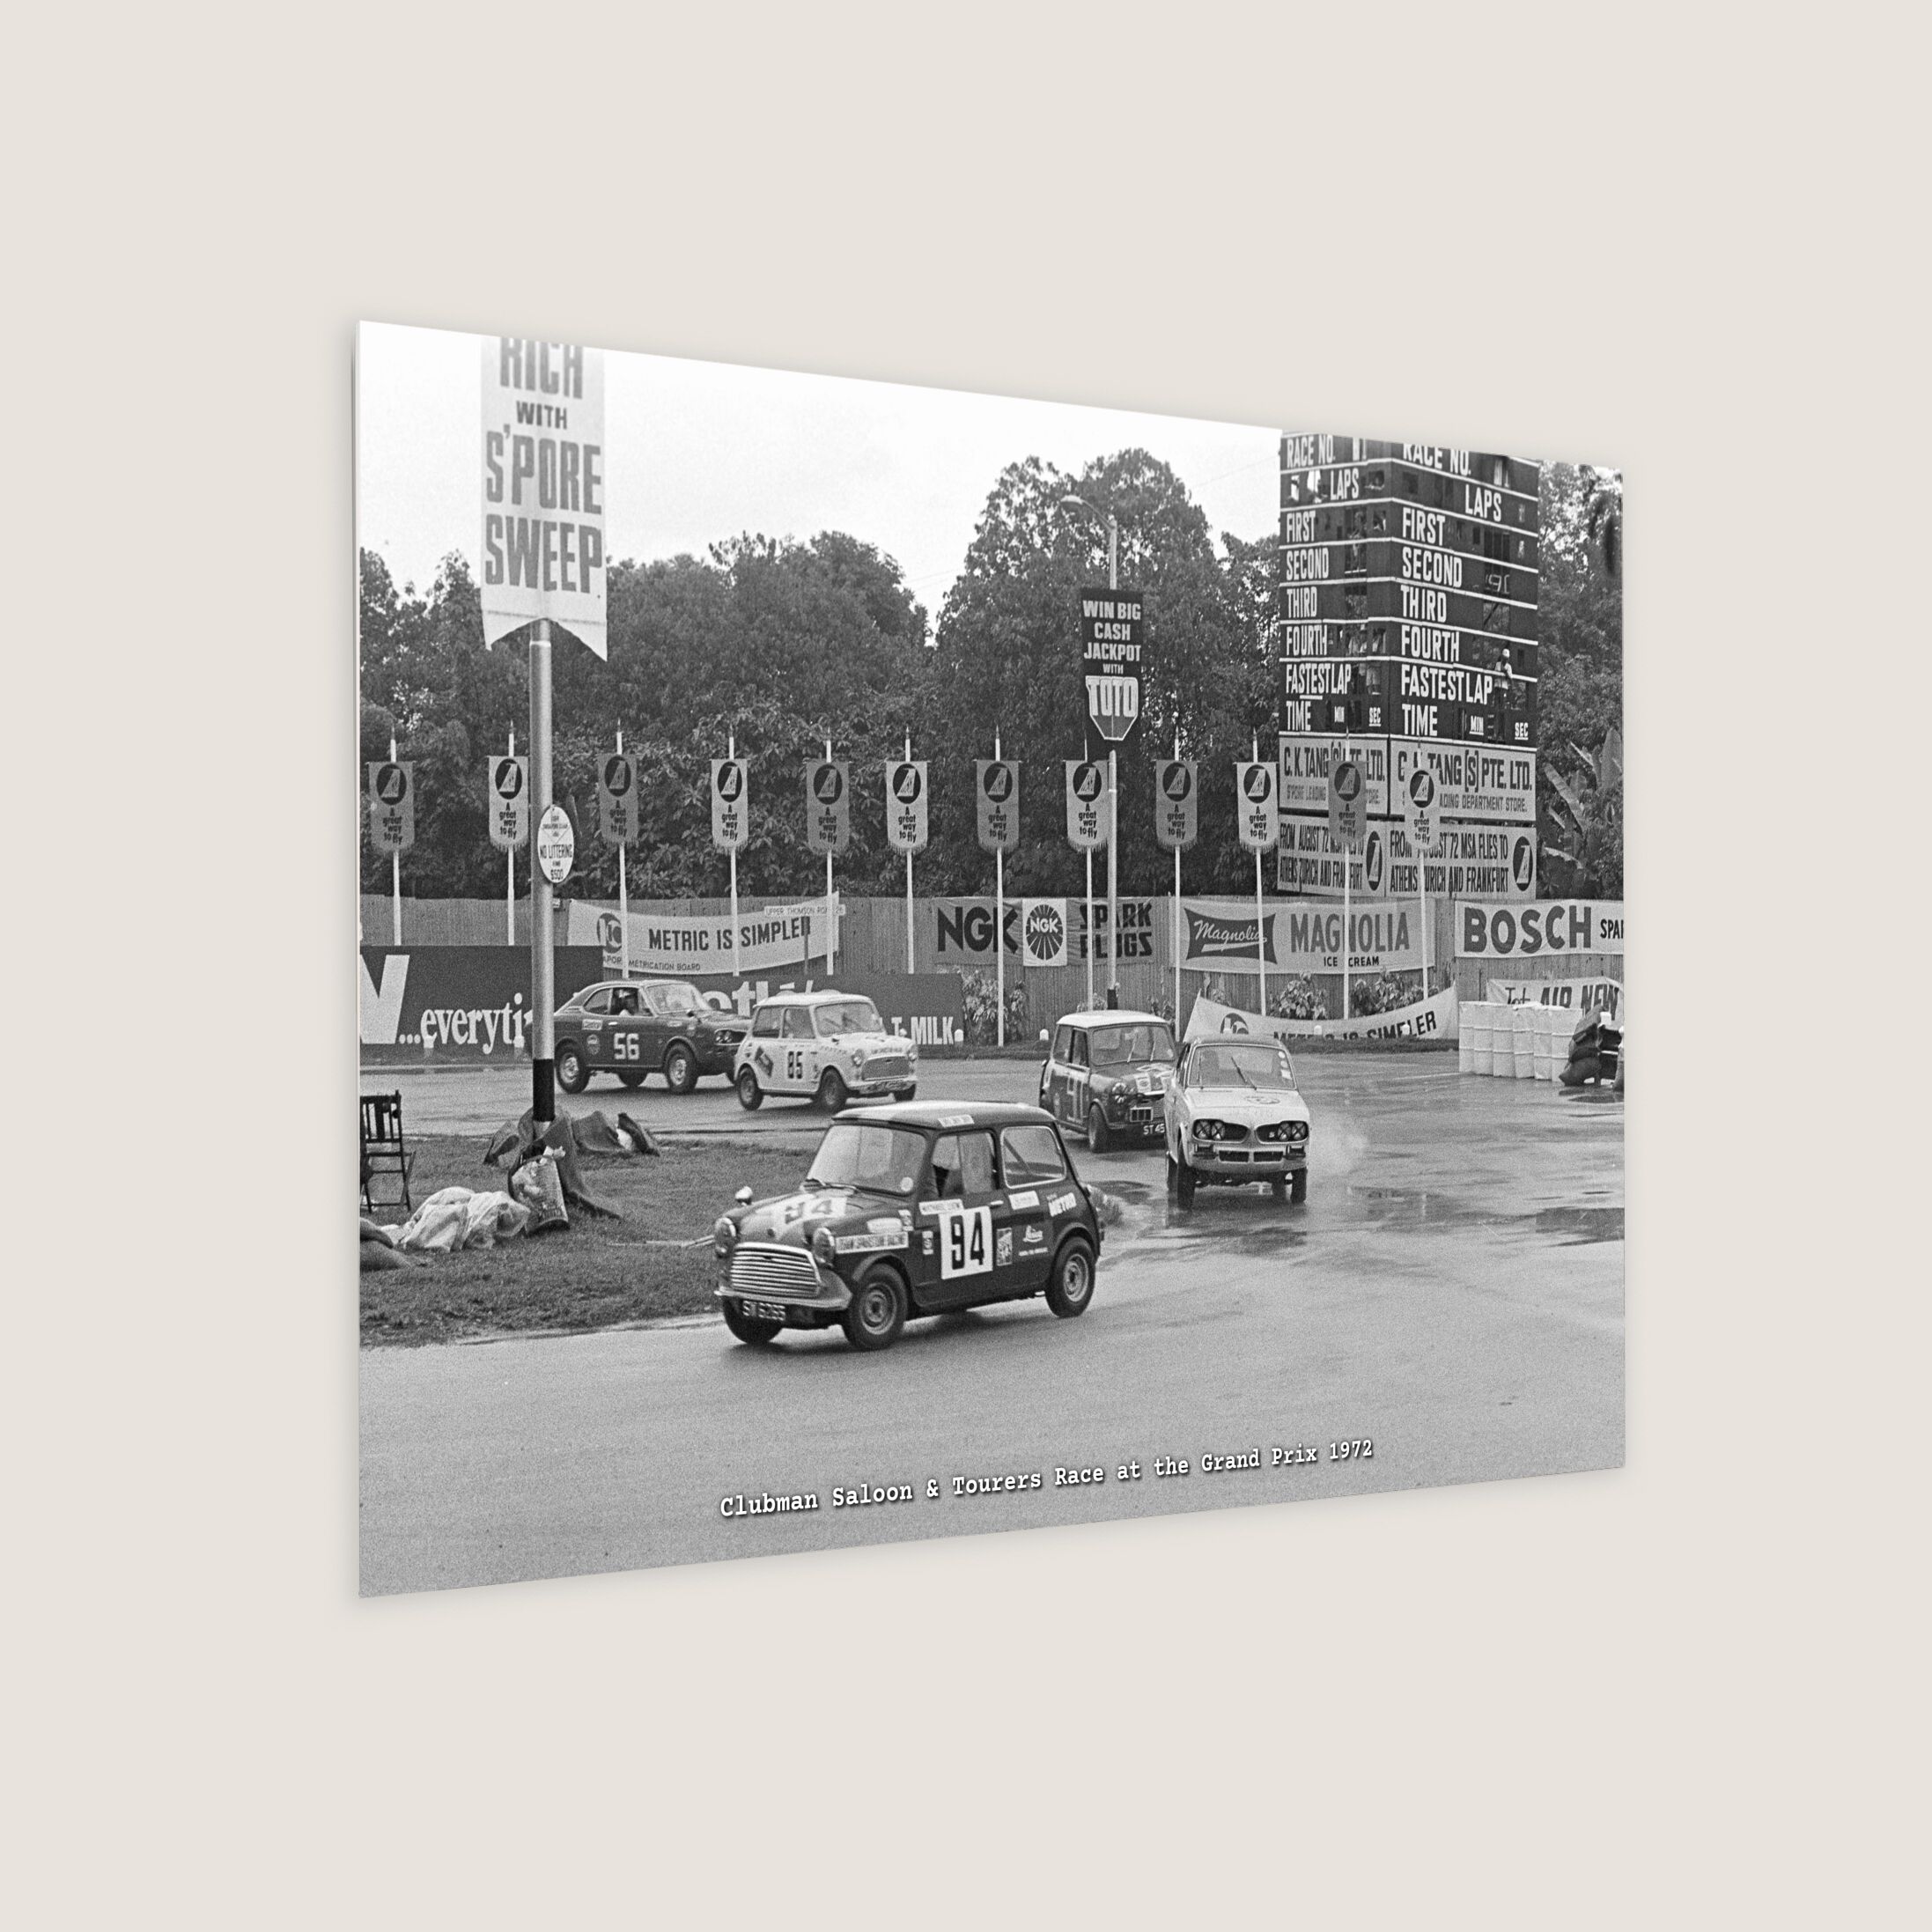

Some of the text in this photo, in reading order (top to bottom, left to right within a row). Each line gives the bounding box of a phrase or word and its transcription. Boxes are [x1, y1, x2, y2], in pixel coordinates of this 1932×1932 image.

[500, 337, 582, 399] RICH
[516, 401, 568, 430] WITH
[1287, 435, 1335, 468] RACE NO.
[1403, 443, 1442, 469] RACE
[485, 424, 602, 515] S'PORE
[1331, 468, 1359, 500] LAPS
[1465, 484, 1501, 521] LAPS
[1287, 510, 1316, 542] FIRST
[1403, 507, 1445, 546] FIRST
[485, 513, 602, 594] SWEEP
[1287, 548, 1329, 580] SECOND
[1402, 547, 1462, 588] SECOND
[1082, 600, 1141, 620] WIN BIG
[1287, 586, 1317, 617] THIRD
[1401, 585, 1446, 623] THIRD
[1094, 622, 1131, 640] CASH
[1287, 624, 1327, 656] FOURTH
[1401, 624, 1459, 661] FOURTH
[1084, 642, 1141, 661] JACKPOT
[1102, 663, 1124, 675] WITH
[1087, 677, 1139, 717] TOTO
[1287, 701, 1311, 731] TIME
[1369, 707, 1381, 723] SEC
[1402, 704, 1529, 737] TIME MIN SEC
[1305, 748, 1329, 778] TANG
[1367, 749, 1385, 782] LTD.
[1428, 753, 1462, 785] TANG
[1482, 758, 1507, 789] PTE.
[1510, 761, 1532, 791] LTD.
[905, 807, 910, 815] A
[1079, 811, 1096, 821] great
[1440, 793, 1459, 808] ADING
[1463, 795, 1502, 811] DEPARTMENT
[898, 815, 916, 824] great
[903, 823, 916, 832] way
[1088, 828, 1097, 839] fly
[907, 833, 917, 843] fly
[1461, 833, 1476, 859] MSA
[1479, 834, 1497, 859] FLIES
[1500, 835, 1508, 859] TO
[1390, 866, 1508, 893] ATHENS URICH AND FRANKFURT
[937, 906, 1019, 954] NGK
[1030, 917, 1058, 933] NGK
[1080, 903, 1152, 929] SPRK
[1464, 905, 1591, 954] BOSCH
[649, 928, 709, 951] METRIC
[717, 928, 733, 950] IS
[1193, 920, 1266, 945] Magnolia
[1290, 912, 1409, 953] MAGNOLIA
[629, 959, 701, 971] METRICATION BOARD
[1324, 956, 1379, 968] ICE CREAM
[614, 1032, 639, 1059] 56
[1143, 1125, 1154, 1135] ST
[950, 1212, 984, 1270] 94
